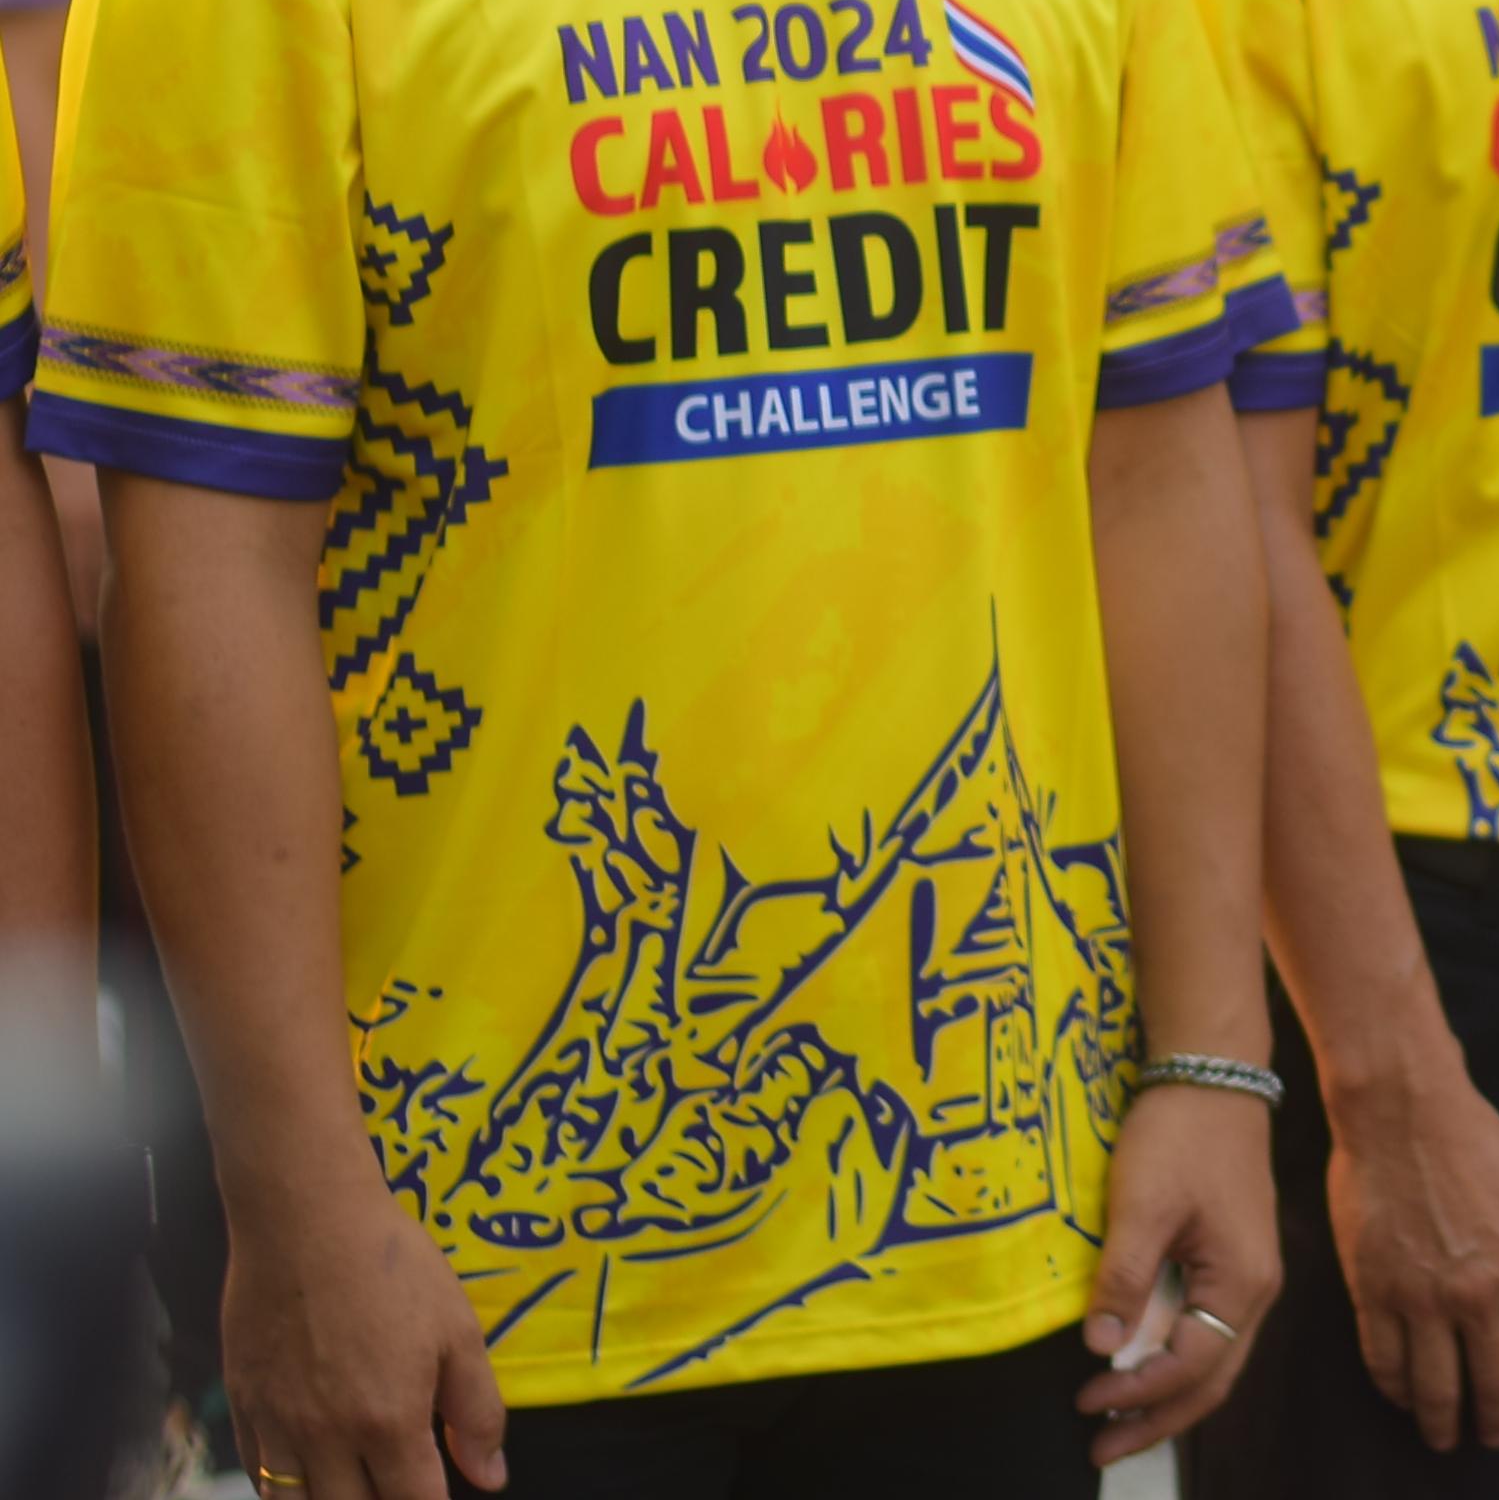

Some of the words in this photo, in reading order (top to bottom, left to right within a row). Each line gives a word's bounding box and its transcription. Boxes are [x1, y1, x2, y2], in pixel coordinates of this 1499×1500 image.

[557, 8, 721, 105] NAN
[587, 201, 1042, 367] CREDIT
[673, 368, 981, 444] CHALLENGE
